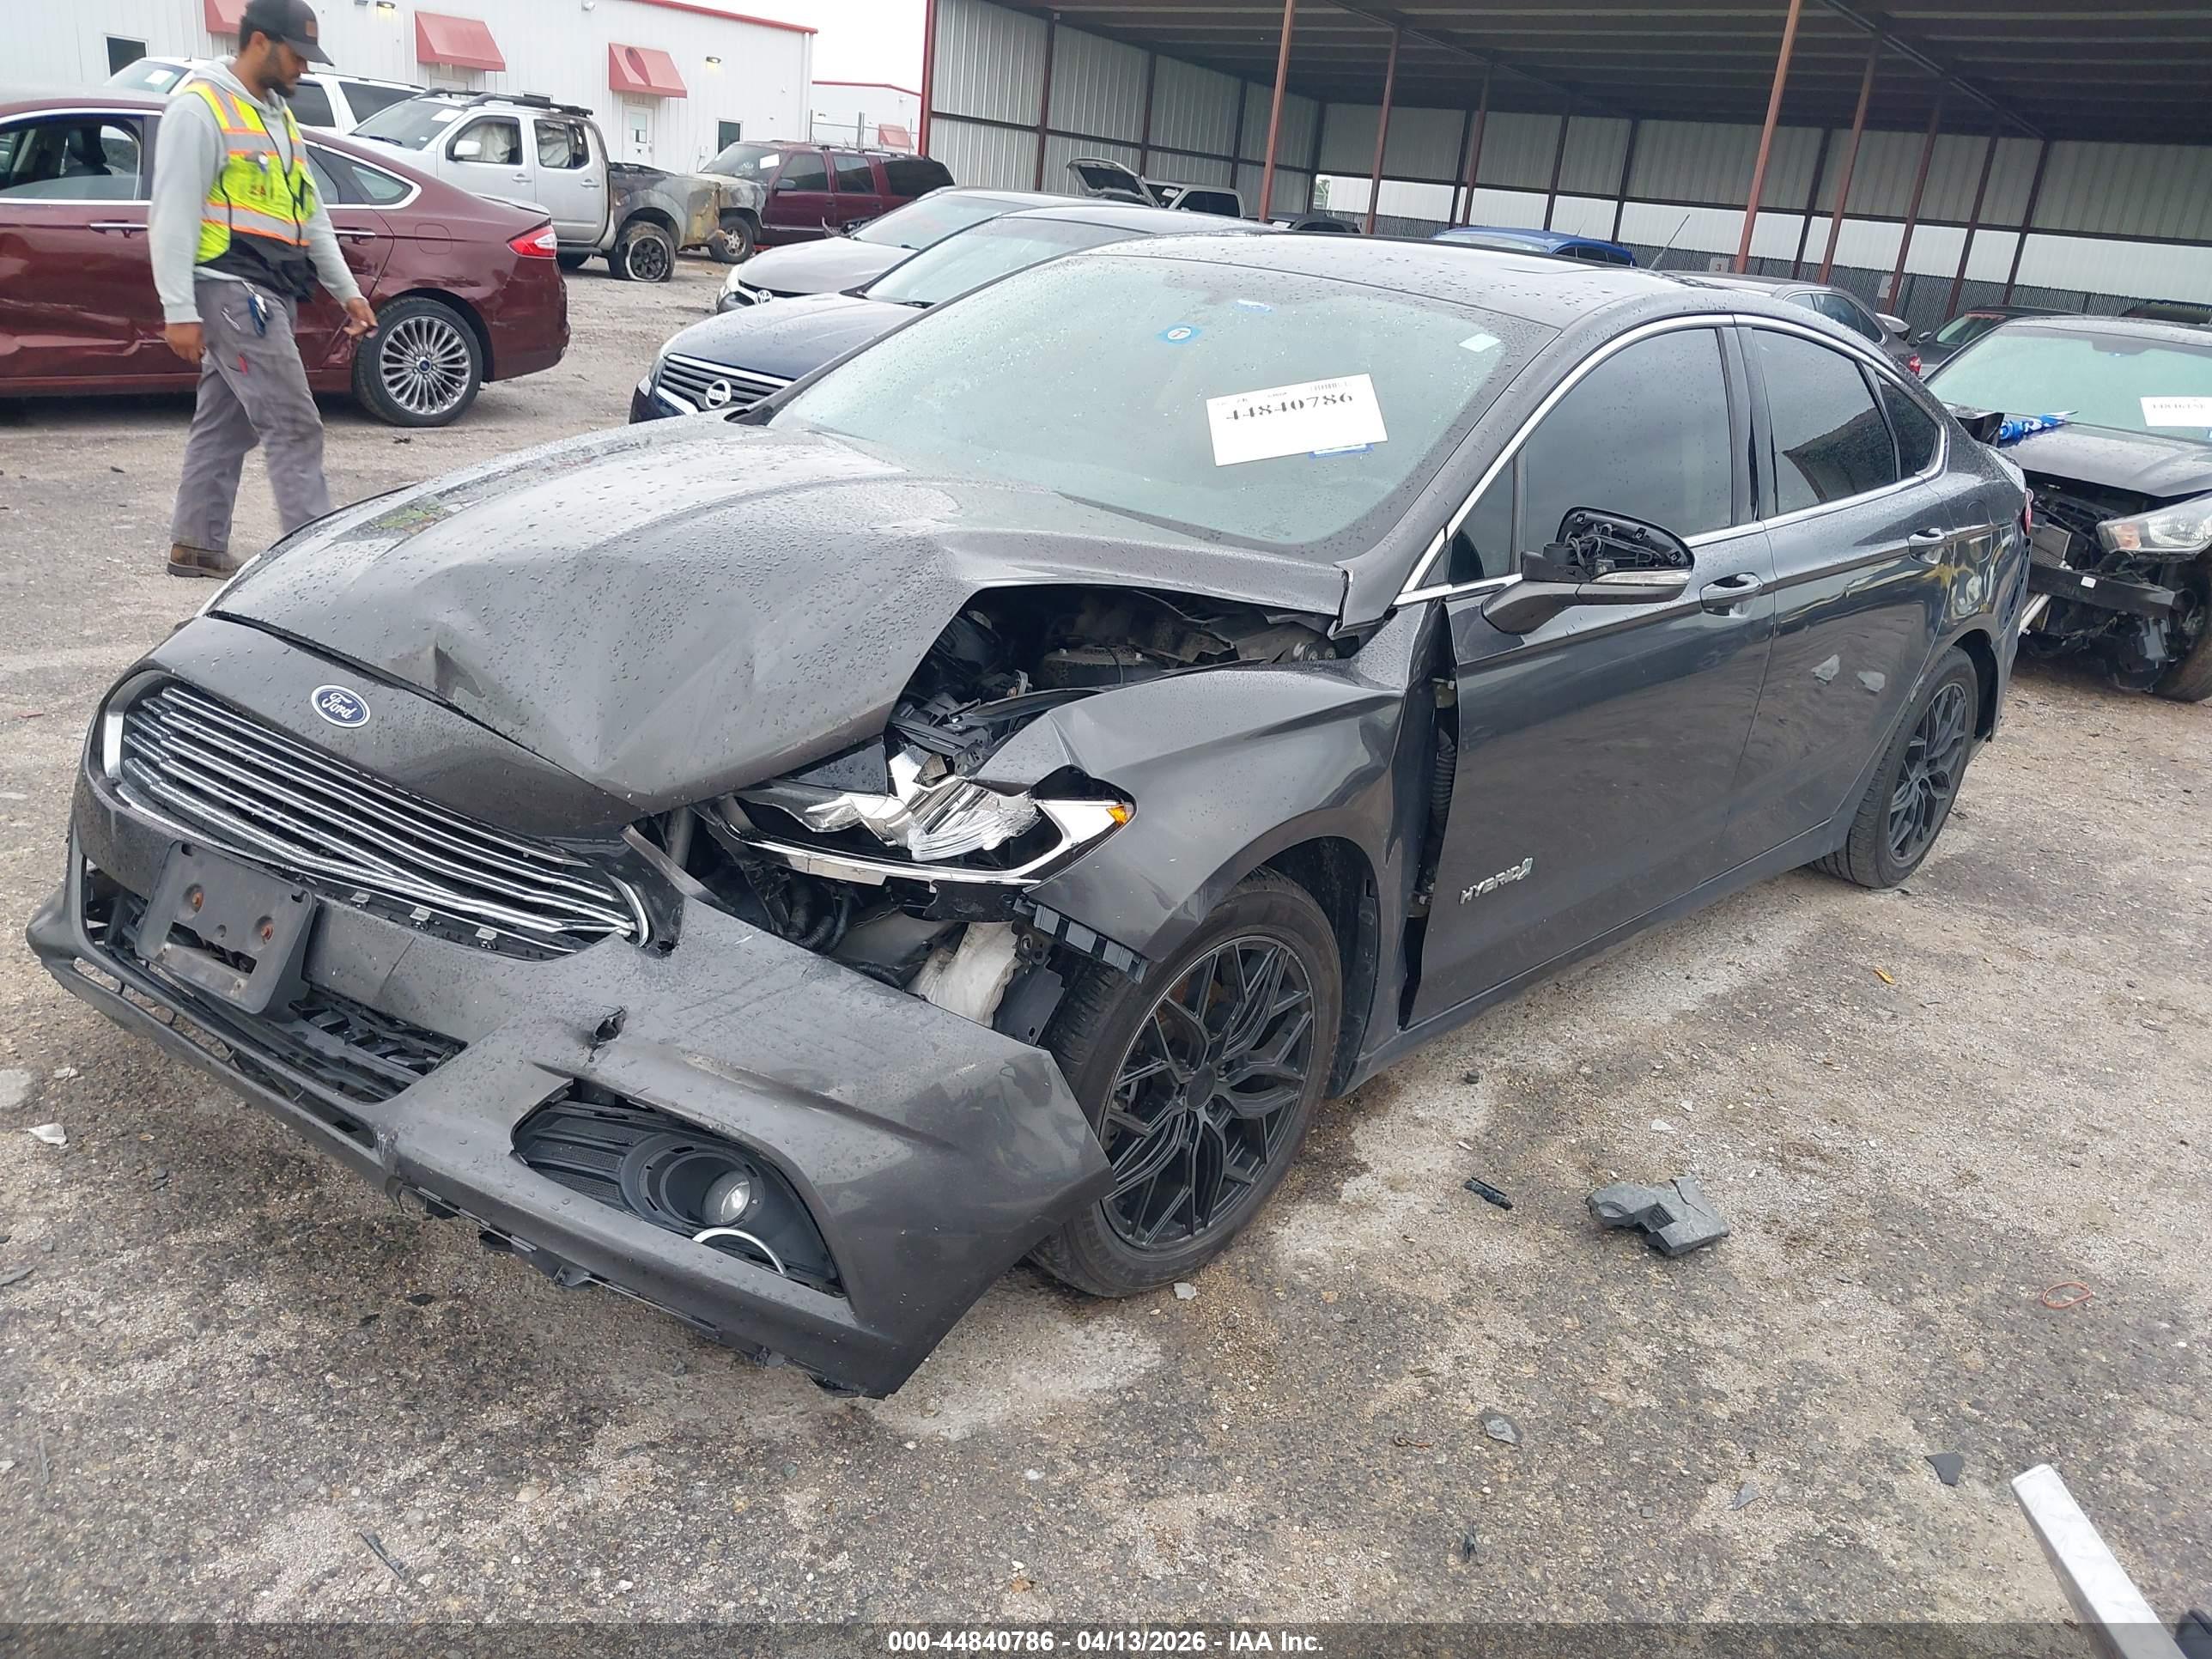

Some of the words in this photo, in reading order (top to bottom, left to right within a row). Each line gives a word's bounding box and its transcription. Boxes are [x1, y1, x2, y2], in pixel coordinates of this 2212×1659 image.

[1225, 392, 1353, 421] 44840786
[321, 692, 358, 720] Ford
[1460, 865, 1522, 905] HYBRID
